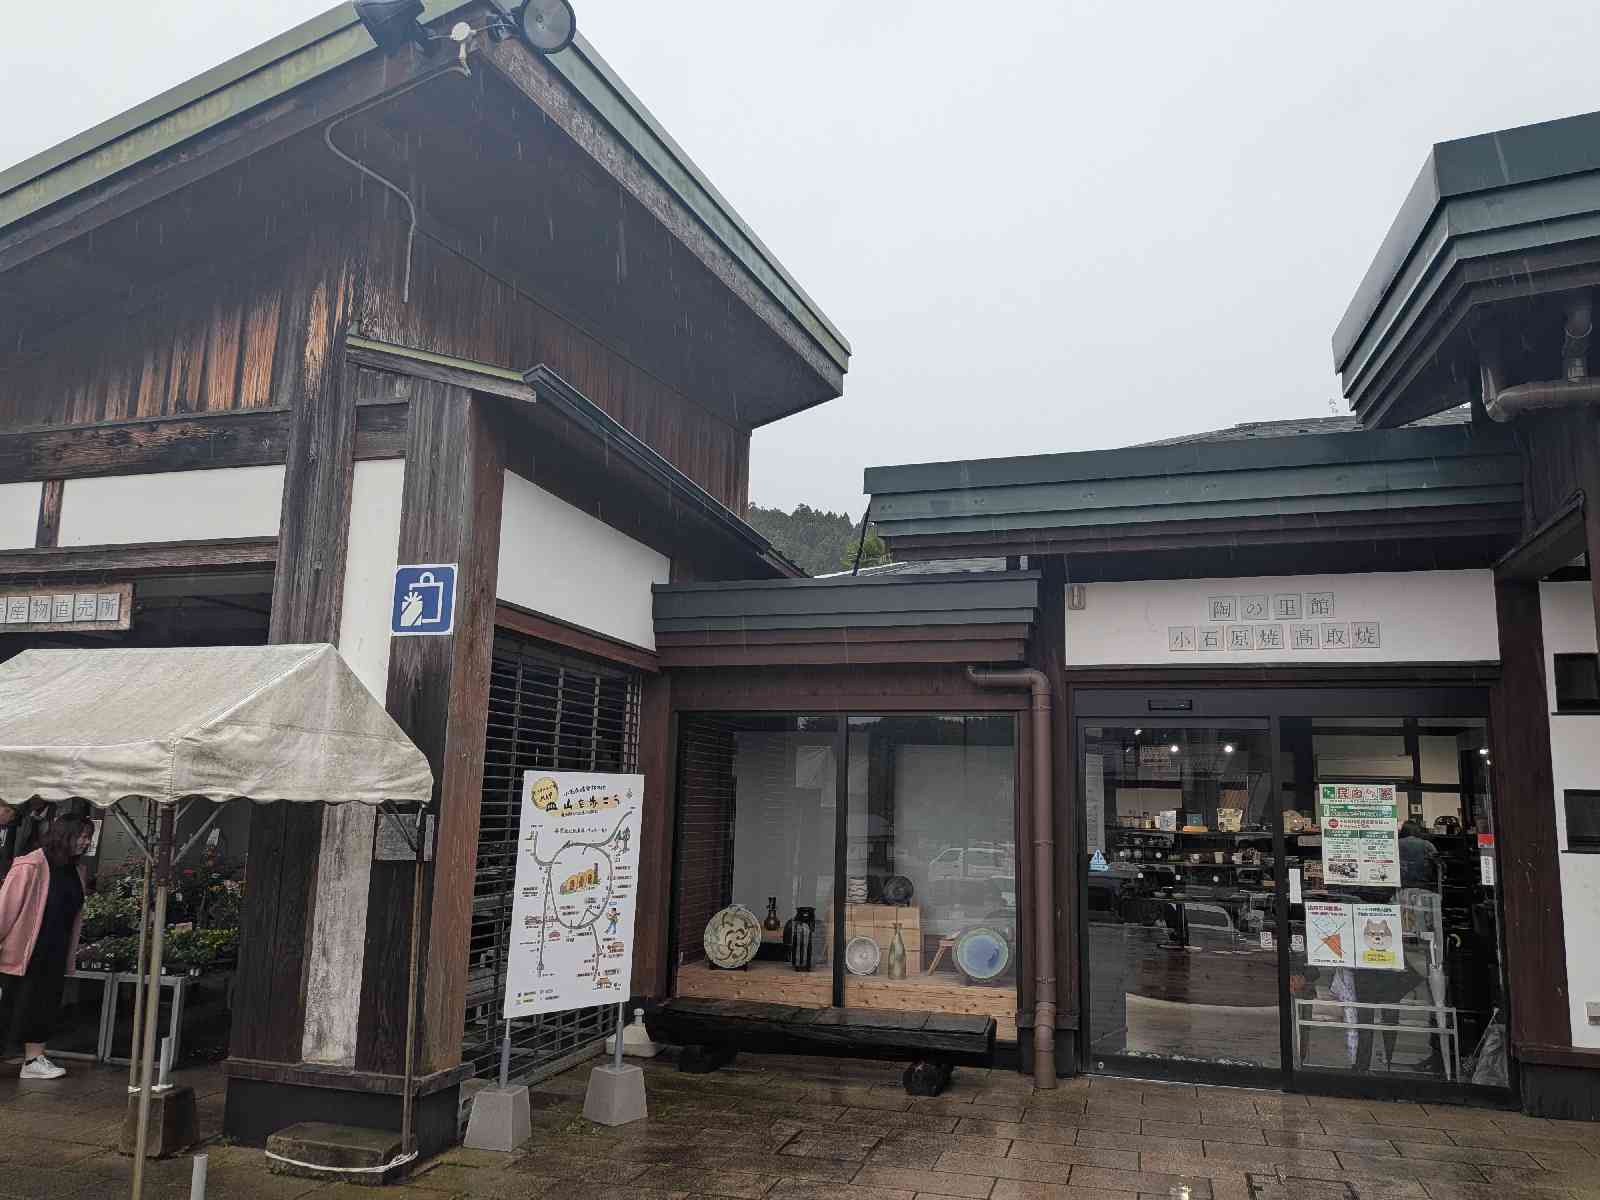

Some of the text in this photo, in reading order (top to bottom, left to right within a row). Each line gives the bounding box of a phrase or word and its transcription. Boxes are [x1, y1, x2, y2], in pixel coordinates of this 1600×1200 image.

[0, 598, 117, 621] 産物直売所
[1213, 597, 1330, 618] 陶の里館
[1173, 629, 1280, 647] 小石原焼
